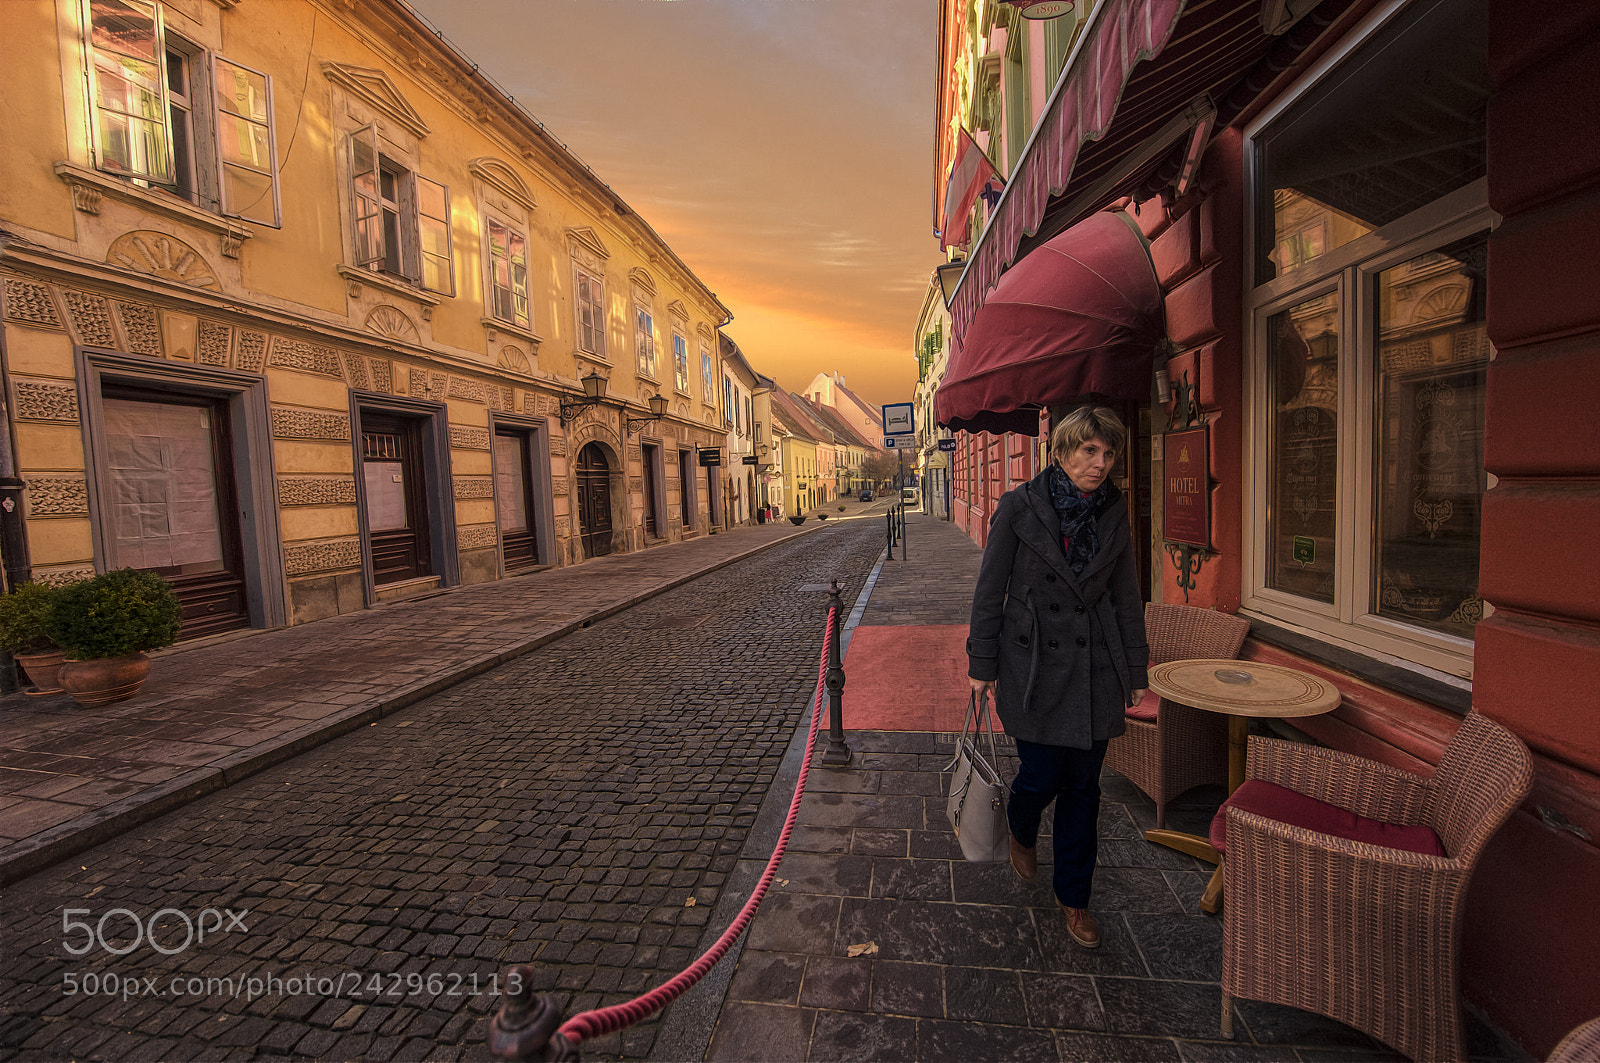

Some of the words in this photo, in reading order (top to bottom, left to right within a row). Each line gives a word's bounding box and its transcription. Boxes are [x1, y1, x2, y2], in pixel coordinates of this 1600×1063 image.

[1036, 4, 1060, 15] 1890
[1171, 477, 1199, 493] HOTEL
[1176, 495, 1192, 506] MITRA
